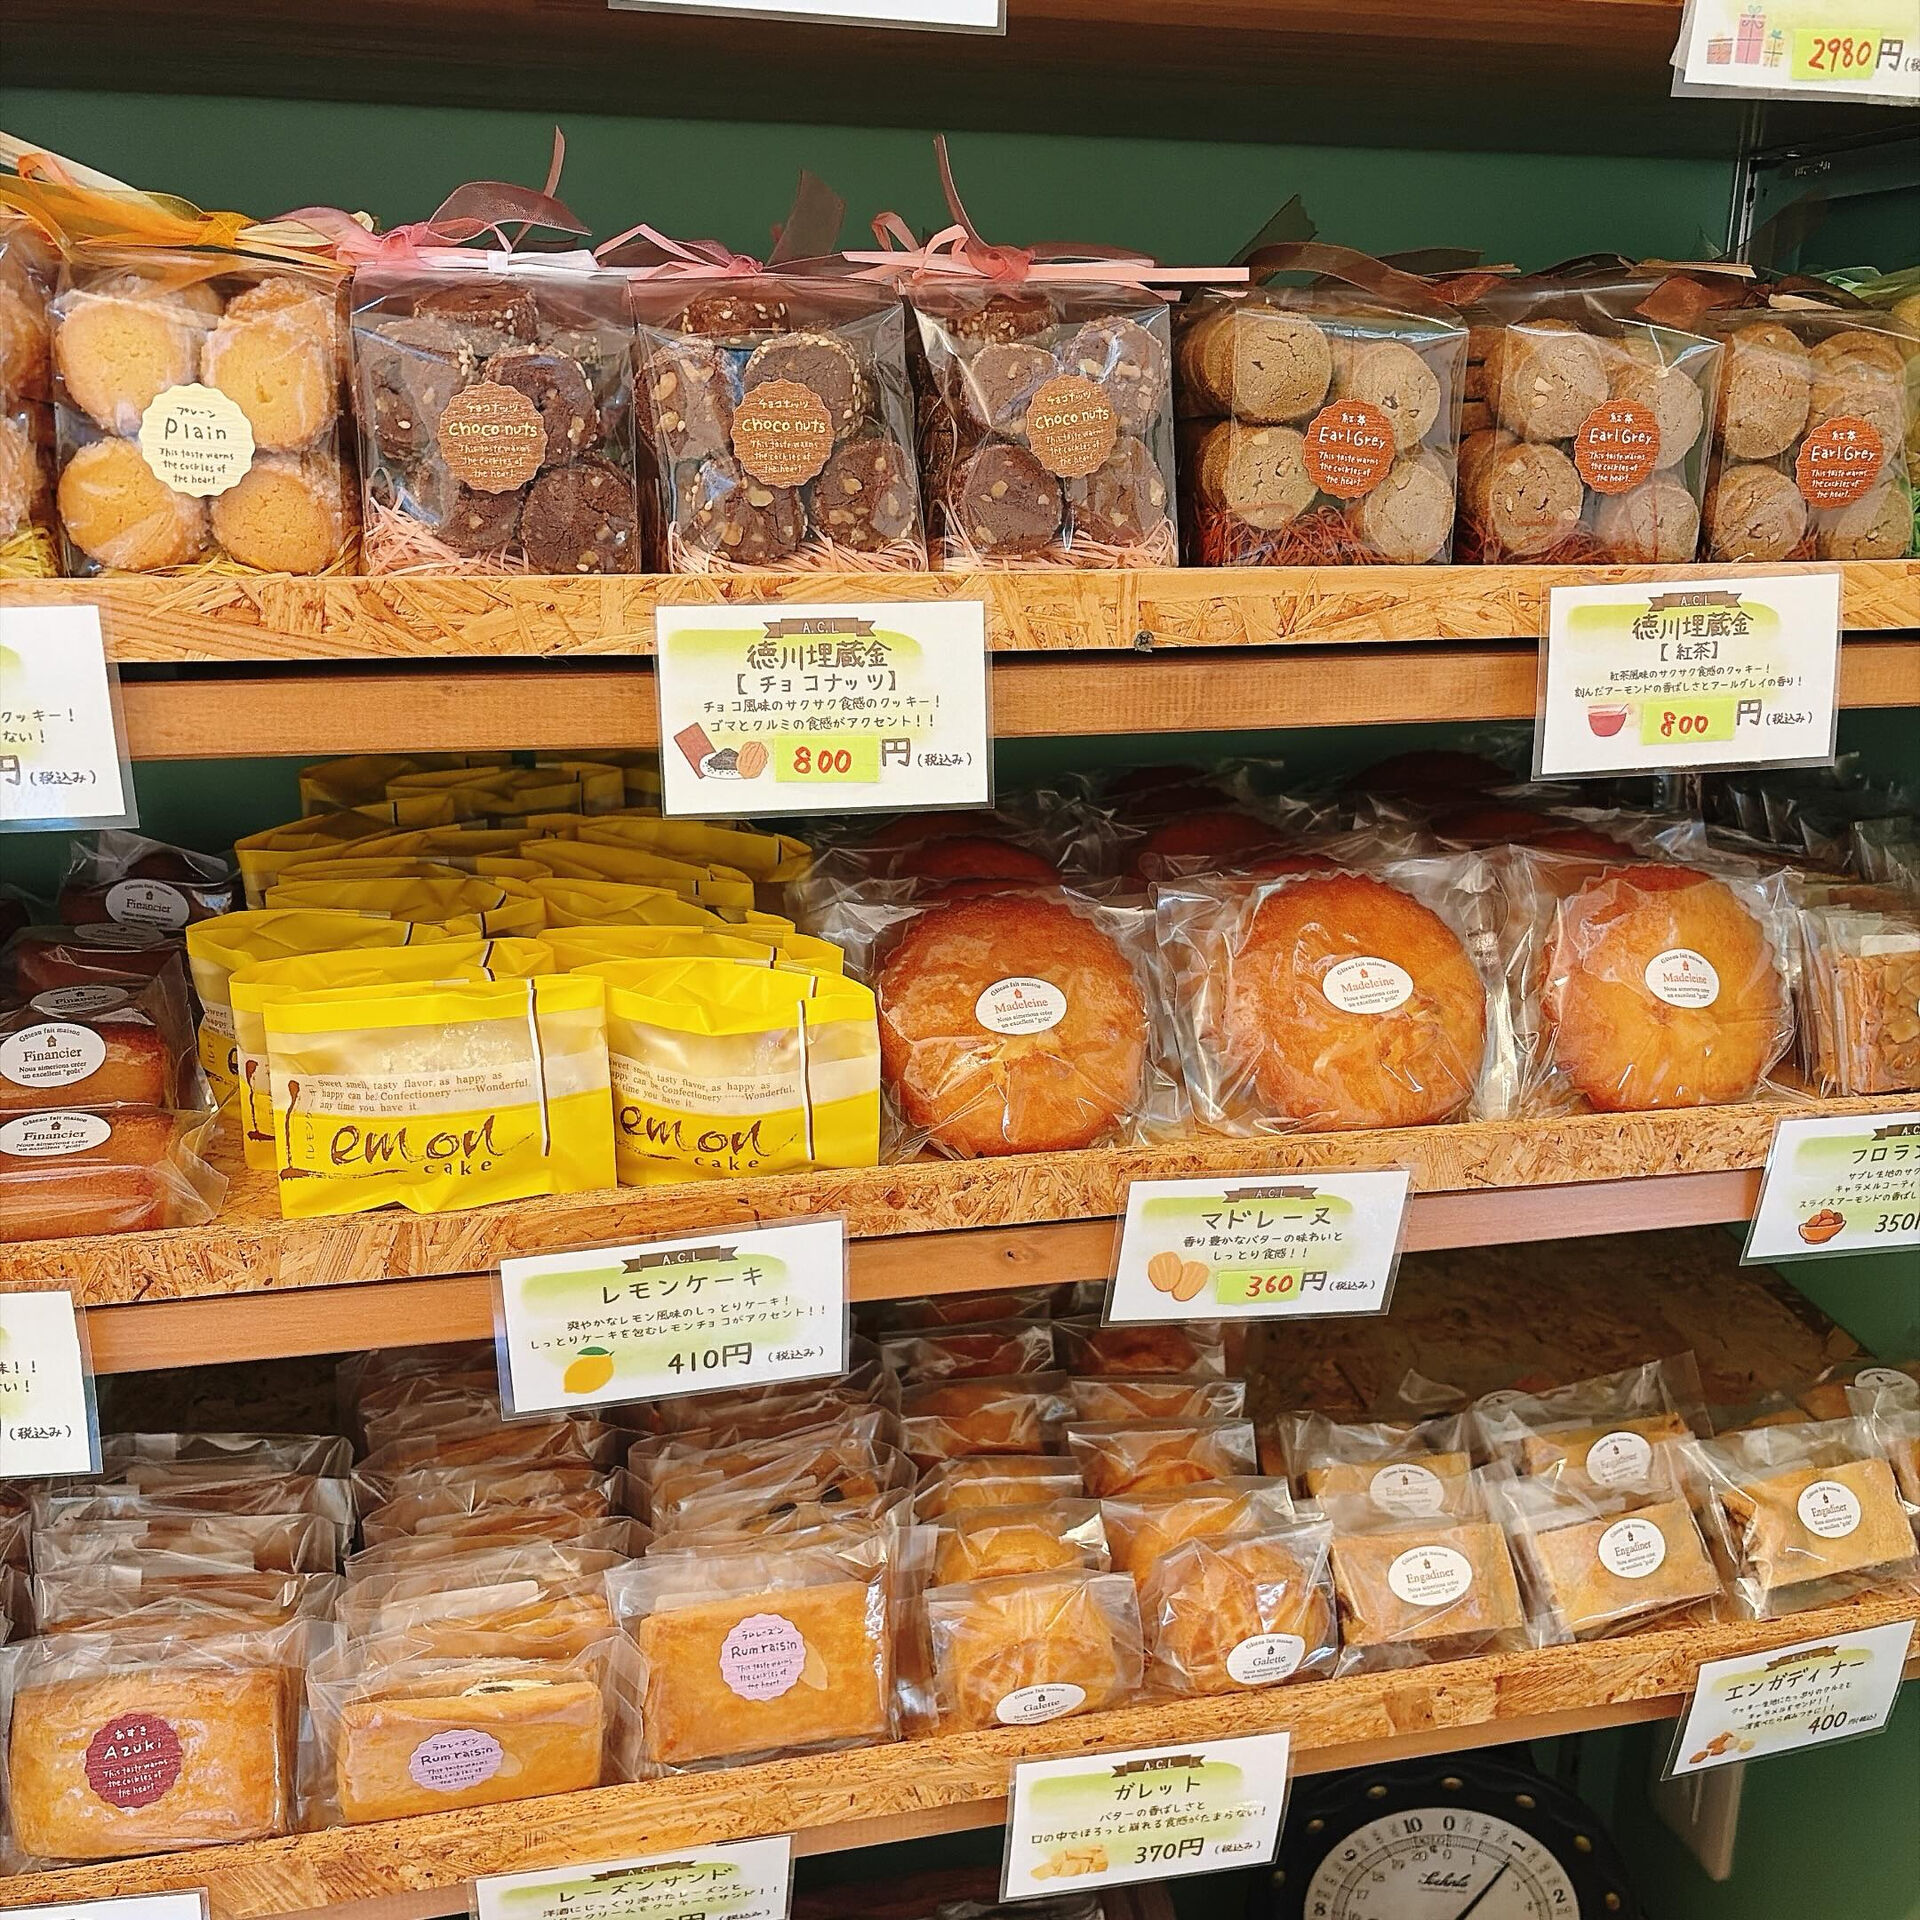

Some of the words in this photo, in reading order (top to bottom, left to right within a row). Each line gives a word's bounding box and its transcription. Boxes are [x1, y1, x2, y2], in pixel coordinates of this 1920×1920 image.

[1808, 37, 1872, 72] 2980
[741, 417, 791, 432] Choco
[795, 418, 826, 433] nuts
[1035, 413, 1078, 429] Choco
[1081, 406, 1109, 421] nuts
[164, 417, 227, 440] Plain
[448, 422, 500, 436] Choco
[505, 422, 537, 437] nuts
[1319, 426, 1350, 444] Earl
[1354, 431, 1386, 449] Grey
[1589, 427, 1619, 444] Earl
[1621, 429, 1652, 445] Grey
[1811, 445, 1841, 462] Earl
[1844, 446, 1876, 462] Grey
[1631, 611, 1755, 641] 徳川埋蔵金
[746, 639, 893, 671] 徳川埋蔵金
[1660, 710, 1709, 737] 800
[1736, 698, 1762, 726] 円
[792, 745, 852, 775] 800
[880, 737, 911, 767] 円
[1340, 977, 1395, 994] Madeleine
[1662, 972, 1707, 984] Madeleine
[994, 998, 1049, 1014] Madeleine
[23, 1047, 83, 1063] Financier
[317, 1079, 342, 1088] Sweet
[373, 1081, 398, 1091] tasty
[456, 1074, 487, 1085] happy
[492, 1071, 503, 1080] as
[633, 1076, 647, 1086] can
[661, 1085, 722, 1103] Confectionery
[656, 1074, 678, 1085] tasty
[726, 1082, 755, 1093] happy
[321, 1090, 345, 1101] happy
[347, 1092, 362, 1101] can
[380, 1089, 451, 1101] Confectionery
[319, 1101, 333, 1110] any
[337, 1101, 355, 1111] time
[359, 1103, 375, 1112] you
[380, 1102, 403, 1112] have
[23, 1130, 86, 1141] Financier
[423, 1159, 493, 1176] cake
[693, 1156, 760, 1170] cake
[1201, 1207, 1331, 1230] マドレーヌ
[602, 1266, 763, 1305] レモンケーキ
[1245, 1274, 1294, 1297] 360
[1405, 1569, 1455, 1584] Engadiner
[731, 1645, 759, 1659] Rum
[761, 1640, 797, 1653] raisin
[1252, 1656, 1287, 1667] Galette
[1724, 1660, 1865, 1701] エンガディナー
[1808, 1711, 1848, 1735] 400
[115, 1725, 147, 1740] あずき
[104, 1738, 162, 1760] Azuki
[421, 1754, 451, 1765] Rum
[454, 1747, 493, 1759] raisin
[1114, 1776, 1201, 1801] ガレット
[1403, 1816, 1423, 1833] 10
[1443, 1815, 1455, 1831] 0
[559, 1866, 733, 1903] レーズンサンド
[1552, 1888, 1567, 1904] 2
[1314, 1901, 1326, 1916] 8
